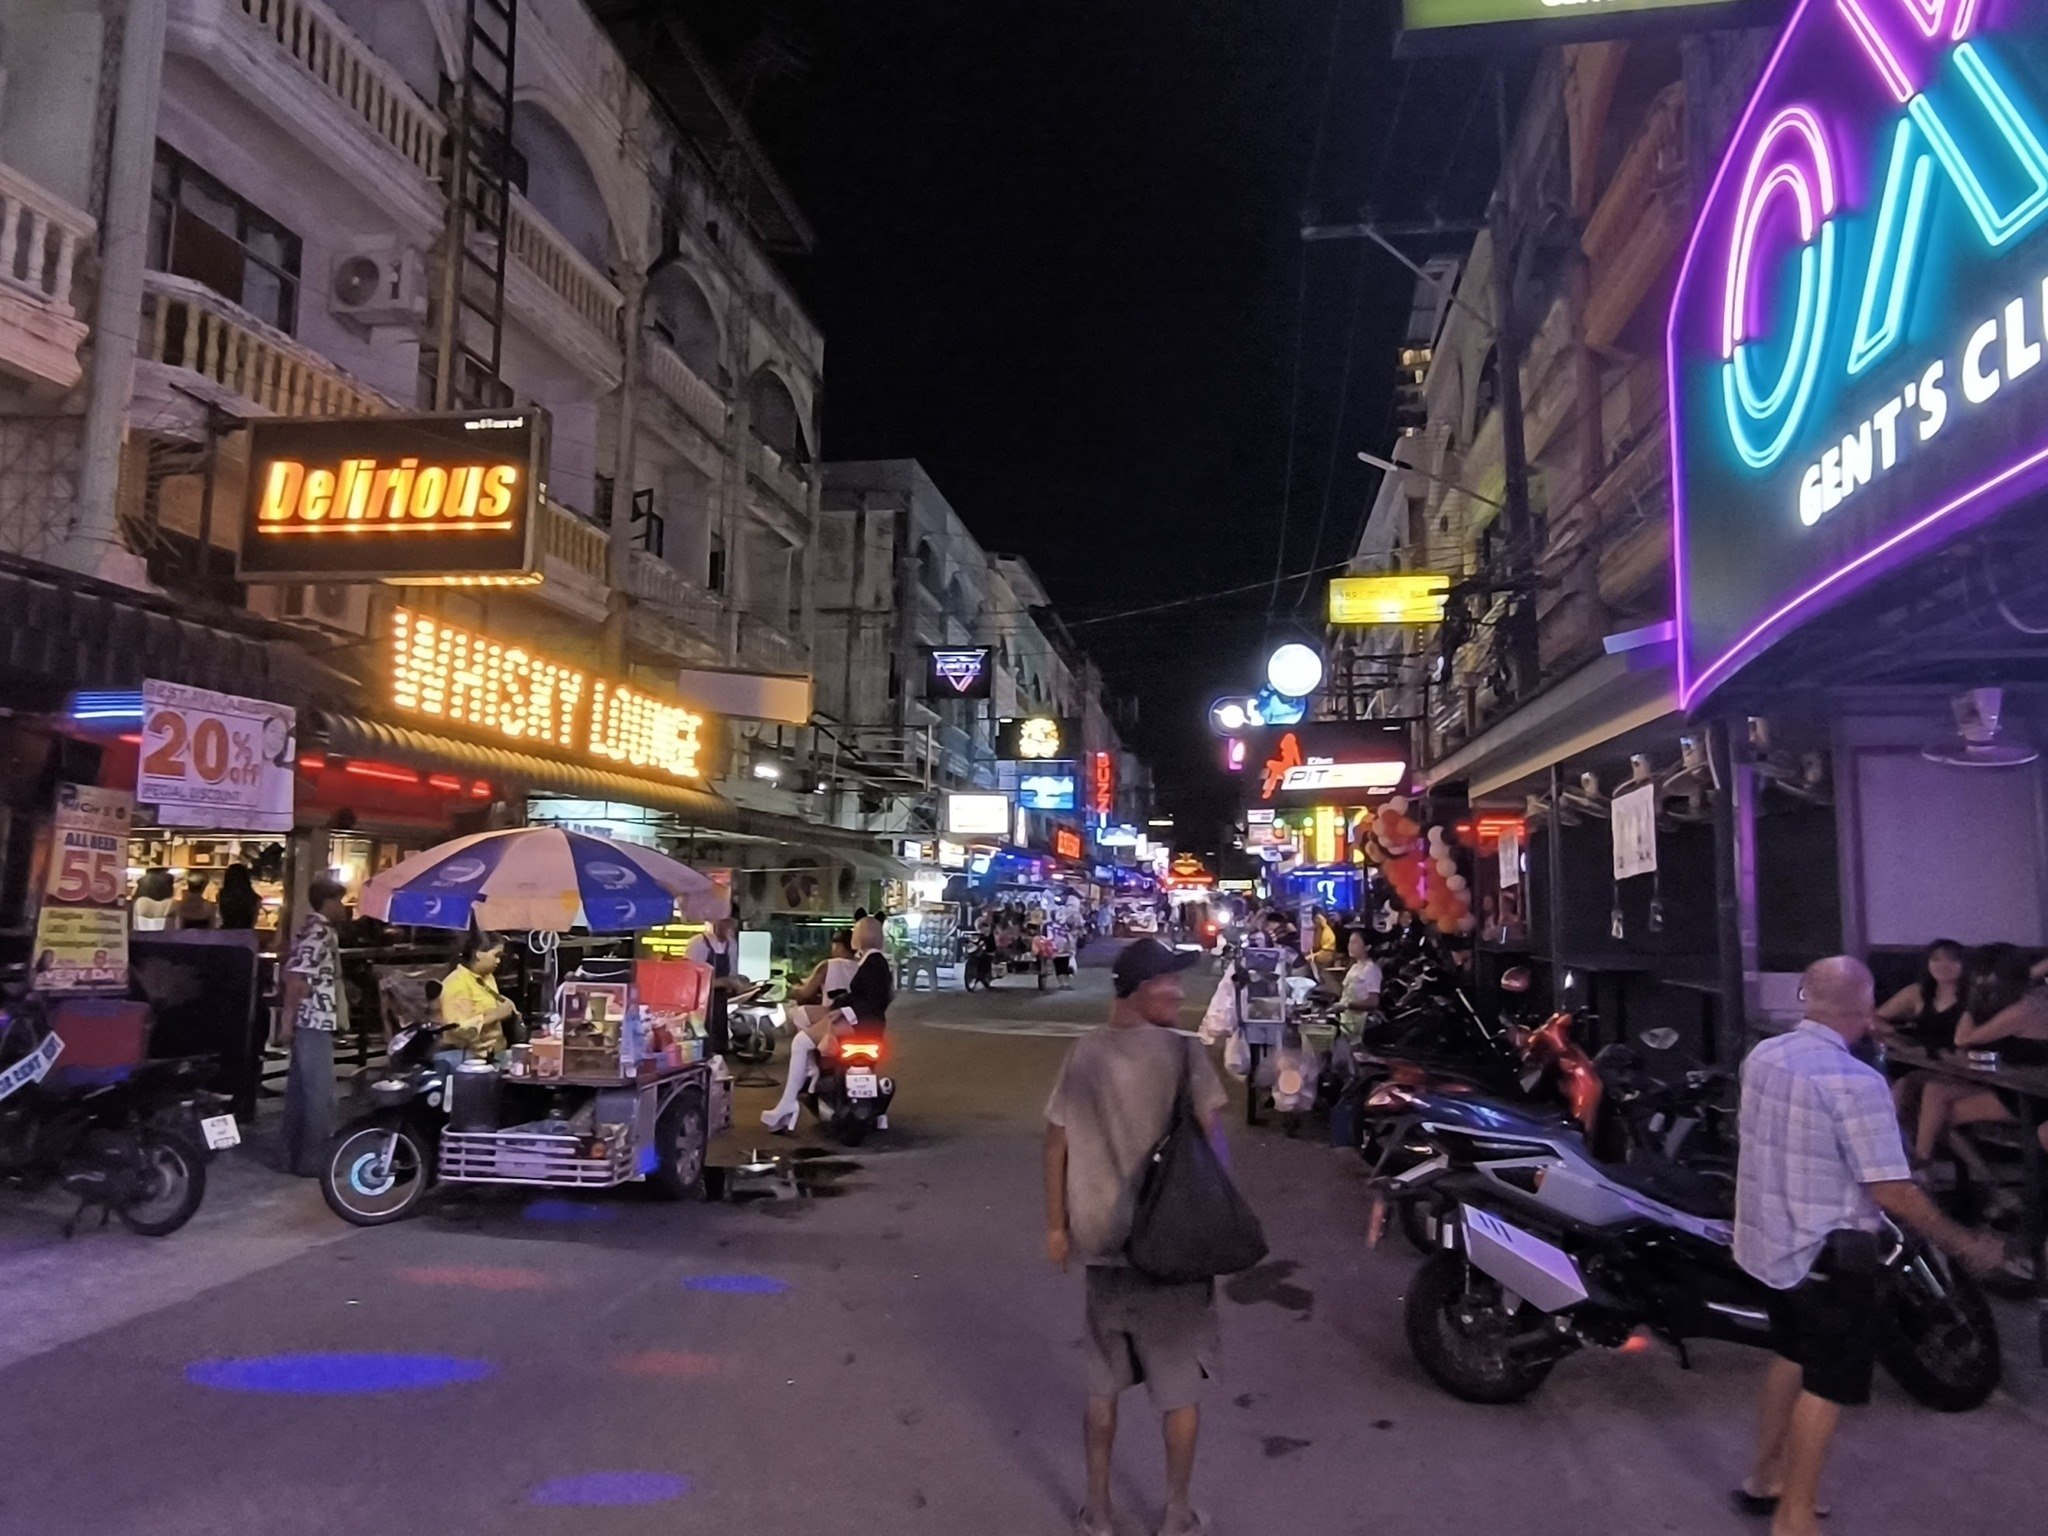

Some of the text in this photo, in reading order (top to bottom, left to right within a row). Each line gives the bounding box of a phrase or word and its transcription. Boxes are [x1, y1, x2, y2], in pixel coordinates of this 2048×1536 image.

[1799, 276, 2048, 527] GENT'S CL
[258, 458, 517, 520] Delirious
[393, 611, 704, 779] WHISKY LOUNGE
[1096, 752, 1110, 814] BUZZ
